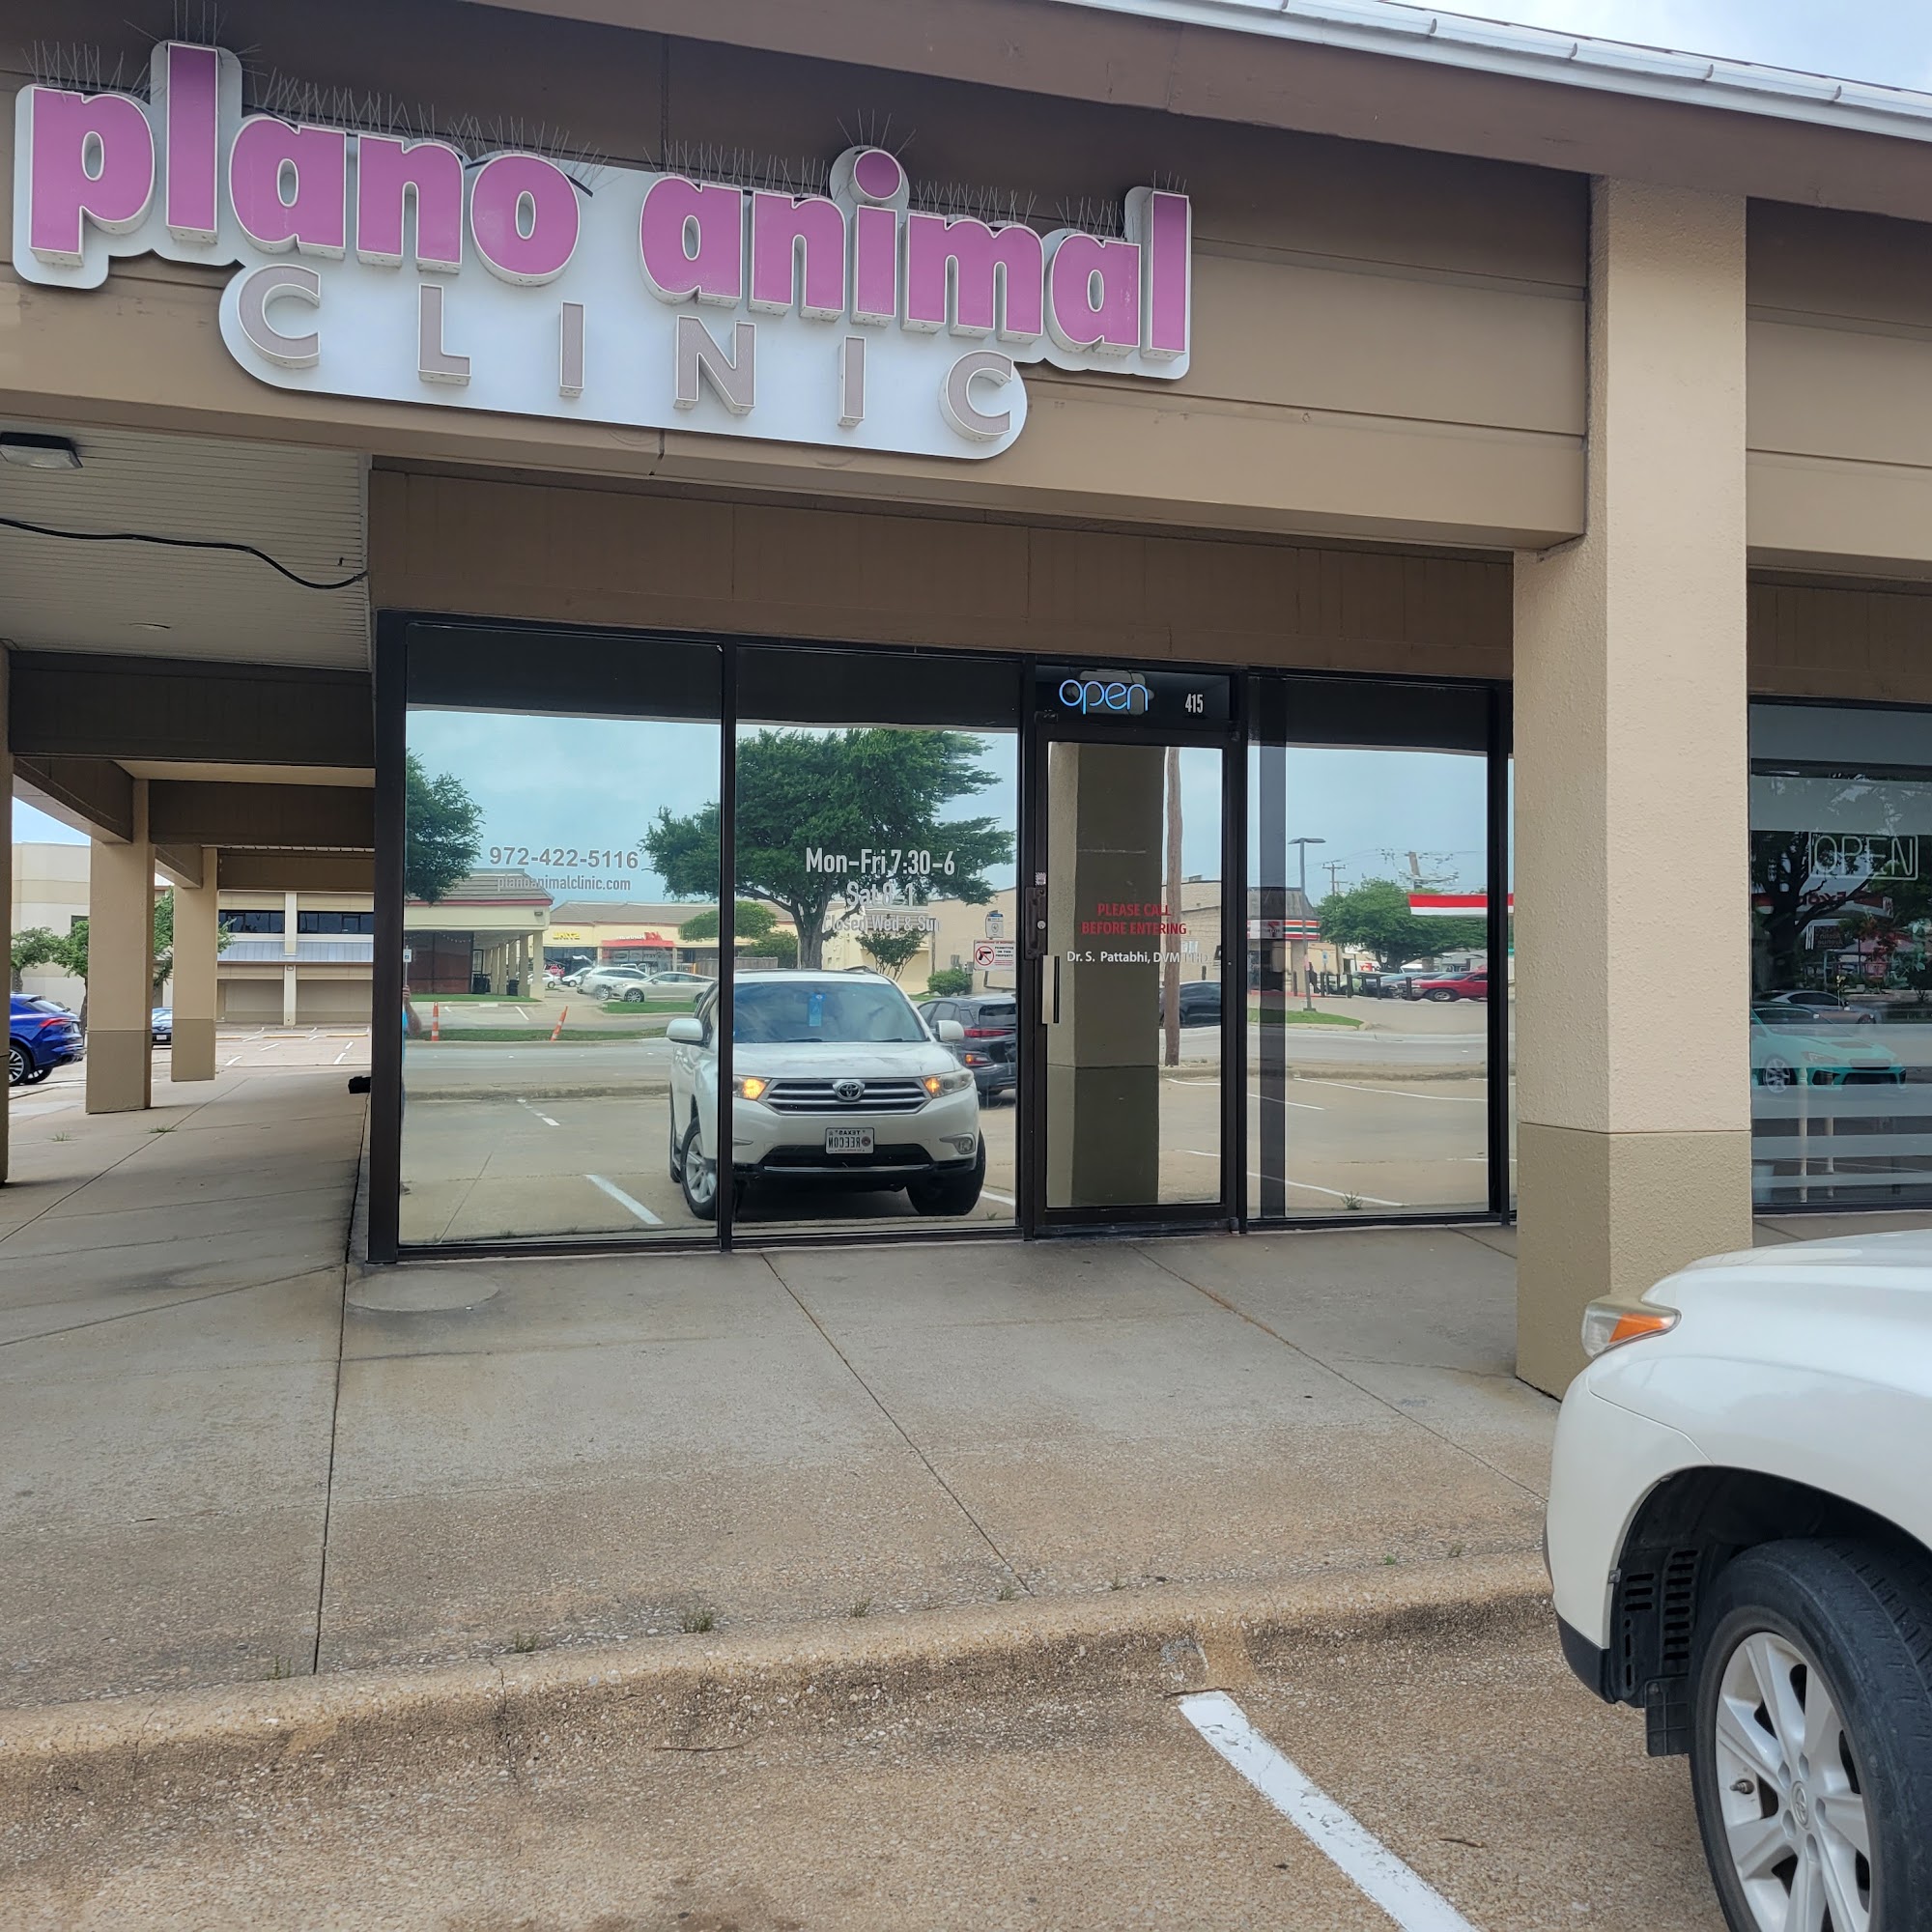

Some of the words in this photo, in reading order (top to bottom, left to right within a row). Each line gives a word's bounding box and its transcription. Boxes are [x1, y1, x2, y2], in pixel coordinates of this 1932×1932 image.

[30, 42, 582, 286] plano
[638, 148, 1190, 360] animal
[237, 263, 1014, 441] CLINIC
[1059, 679, 1149, 715] open
[1184, 694, 1204, 713] 415
[489, 846, 639, 869] 972-422-5116
[806, 847, 886, 874] Mon-Fri
[891, 849, 955, 875] 7:30-6
[1814, 835, 1914, 876] OPEN
[497, 874, 631, 892] planoanimalclinic.com
[846, 881, 878, 907] Sat
[1097, 903, 1140, 917] PLEASE
[1144, 904, 1172, 917] CALL
[823, 914, 867, 932] Closed
[871, 914, 899, 932] Wed
[903, 917, 913, 931] &
[917, 916, 939, 932] Sun
[1081, 922, 1126, 935] BEFORE
[1129, 923, 1187, 935] ENTERING
[1066, 951, 1083, 963] Dr.
[1085, 951, 1095, 963] S.
[1100, 951, 1151, 964] Pattabhi,
